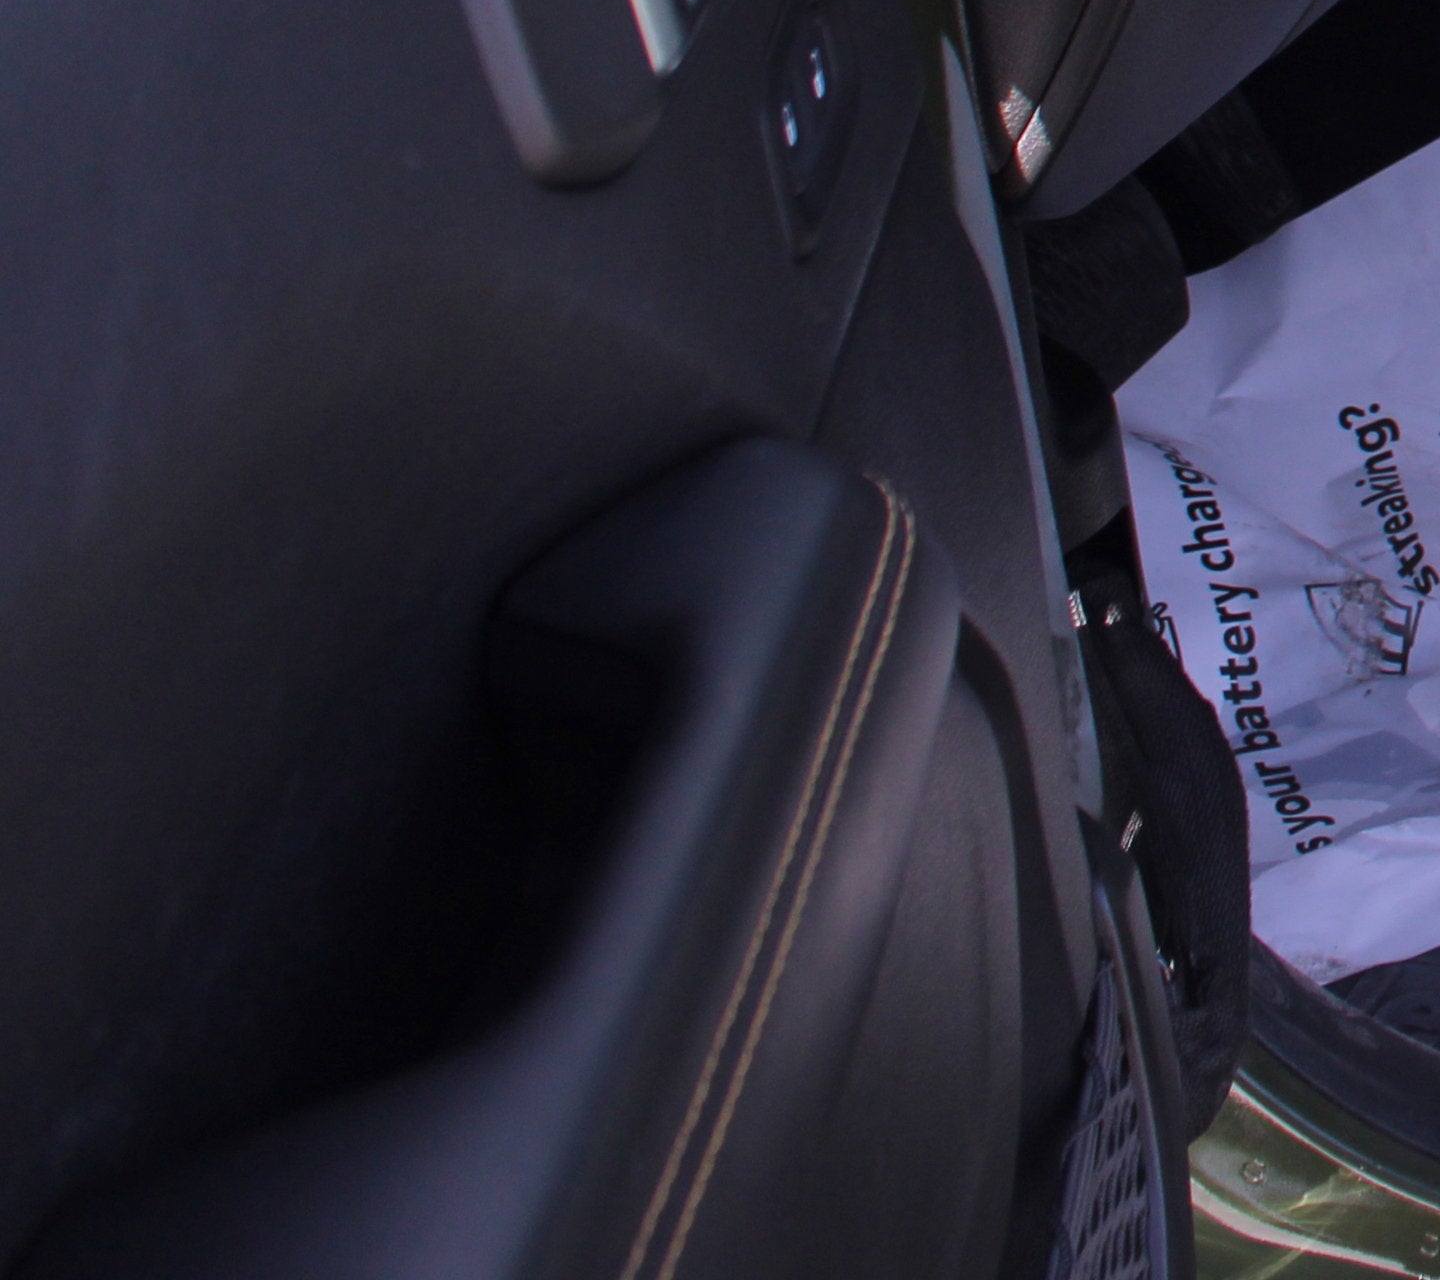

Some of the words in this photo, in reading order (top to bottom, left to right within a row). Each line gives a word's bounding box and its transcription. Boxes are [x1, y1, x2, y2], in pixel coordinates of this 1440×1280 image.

[1338, 402, 1440, 597] streaking?
[1208, 582, 1282, 755] battery
[1254, 761, 1336, 836] your
